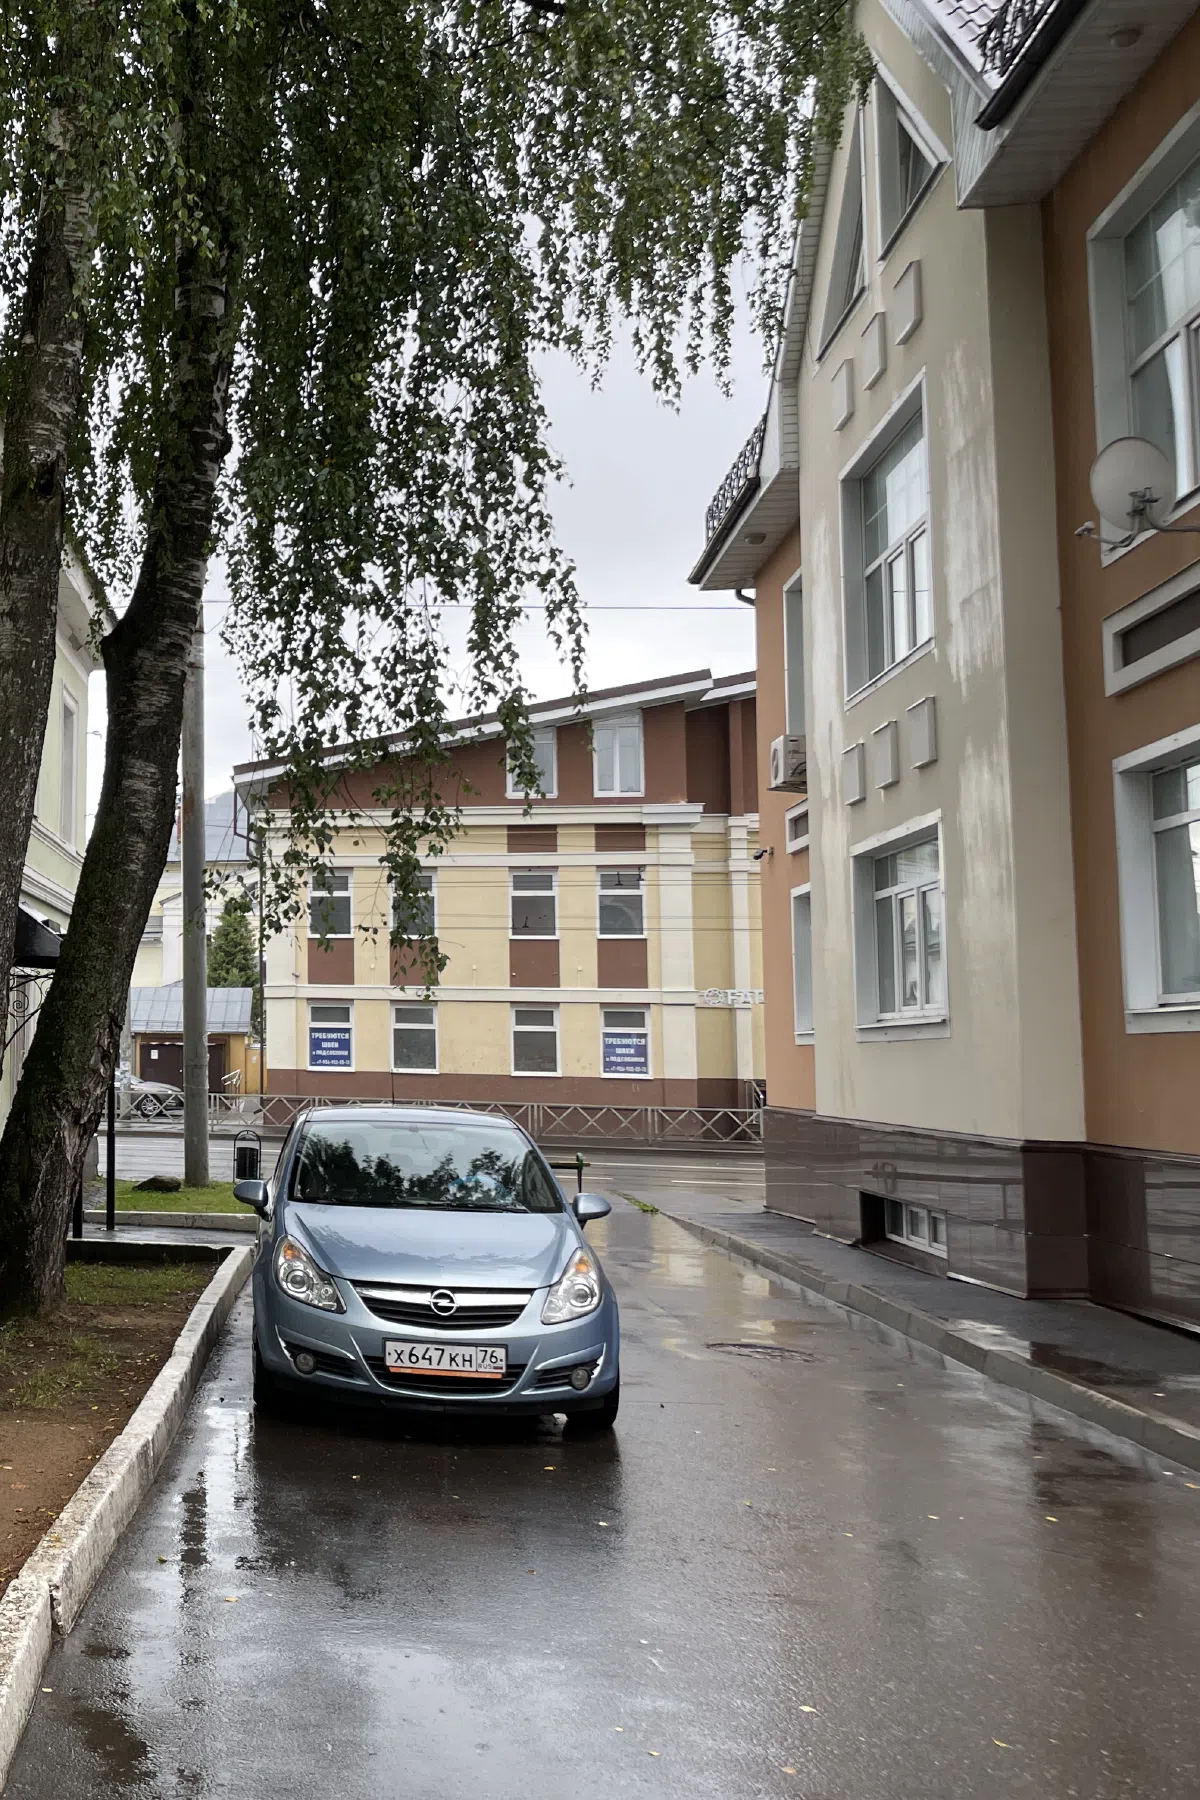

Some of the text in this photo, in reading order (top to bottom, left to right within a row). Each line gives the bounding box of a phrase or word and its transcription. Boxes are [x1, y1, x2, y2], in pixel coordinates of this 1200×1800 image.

[311, 1032, 349, 1040] ТРЕБУЮТСЯ
[604, 1037, 646, 1046] ТРЕБУЮТСЯ
[479, 1349, 499, 1364] 76
[477, 1362, 493, 1370] RUS
